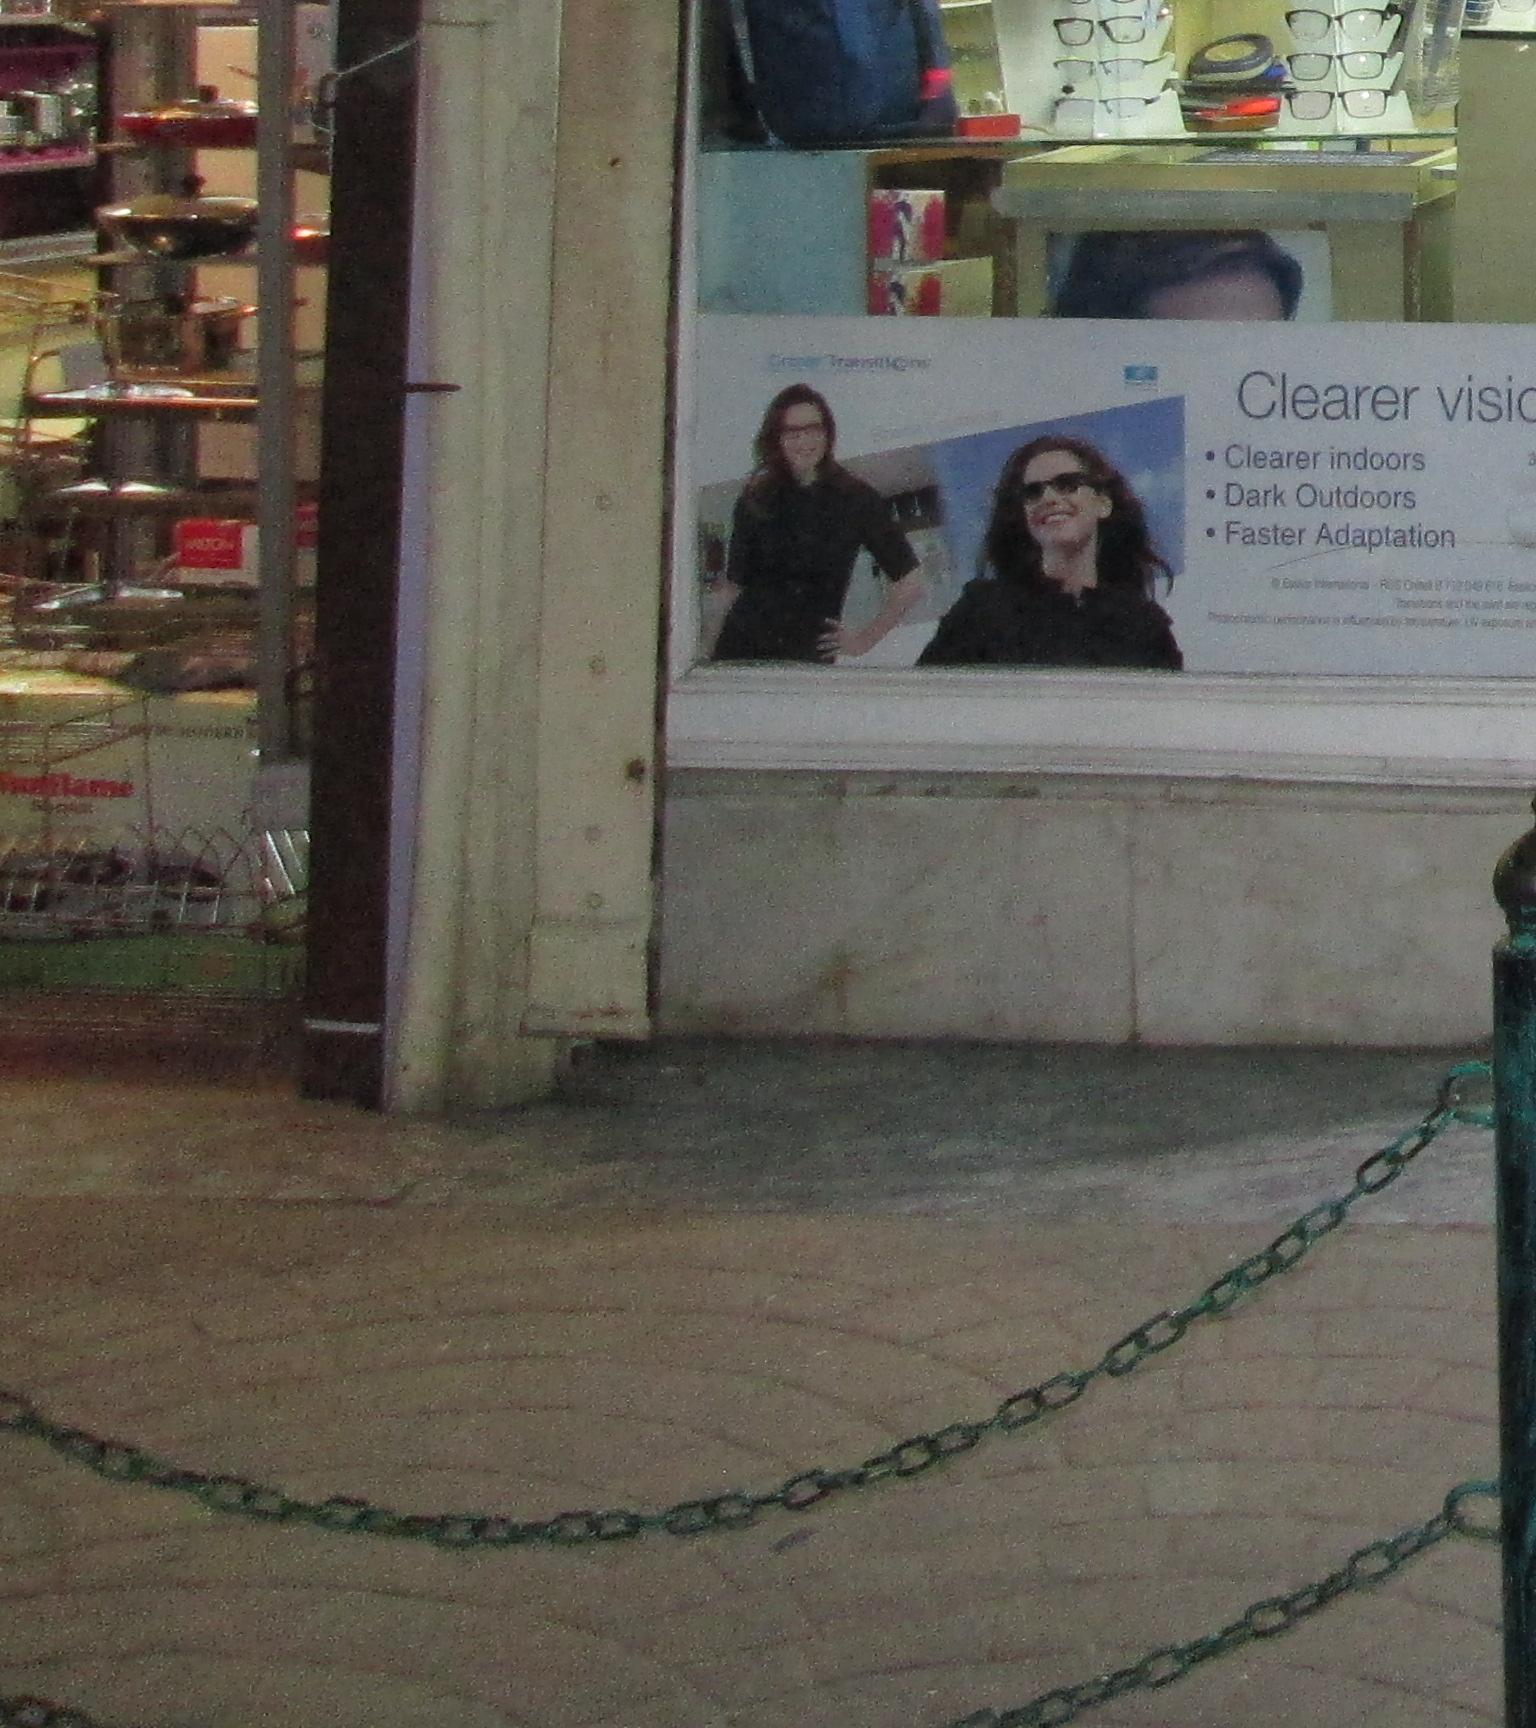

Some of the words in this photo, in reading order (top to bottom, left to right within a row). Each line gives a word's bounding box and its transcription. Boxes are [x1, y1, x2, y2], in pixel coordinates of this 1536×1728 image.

[1237, 370, 1420, 421] Clearer
[1224, 444, 1321, 470] Clearer
[1330, 446, 1426, 472] indoors
[1224, 482, 1287, 508] Dark
[1296, 482, 1417, 509] Outdoors
[1224, 520, 1307, 547] Faster
[1314, 522, 1456, 554] Adaptation
